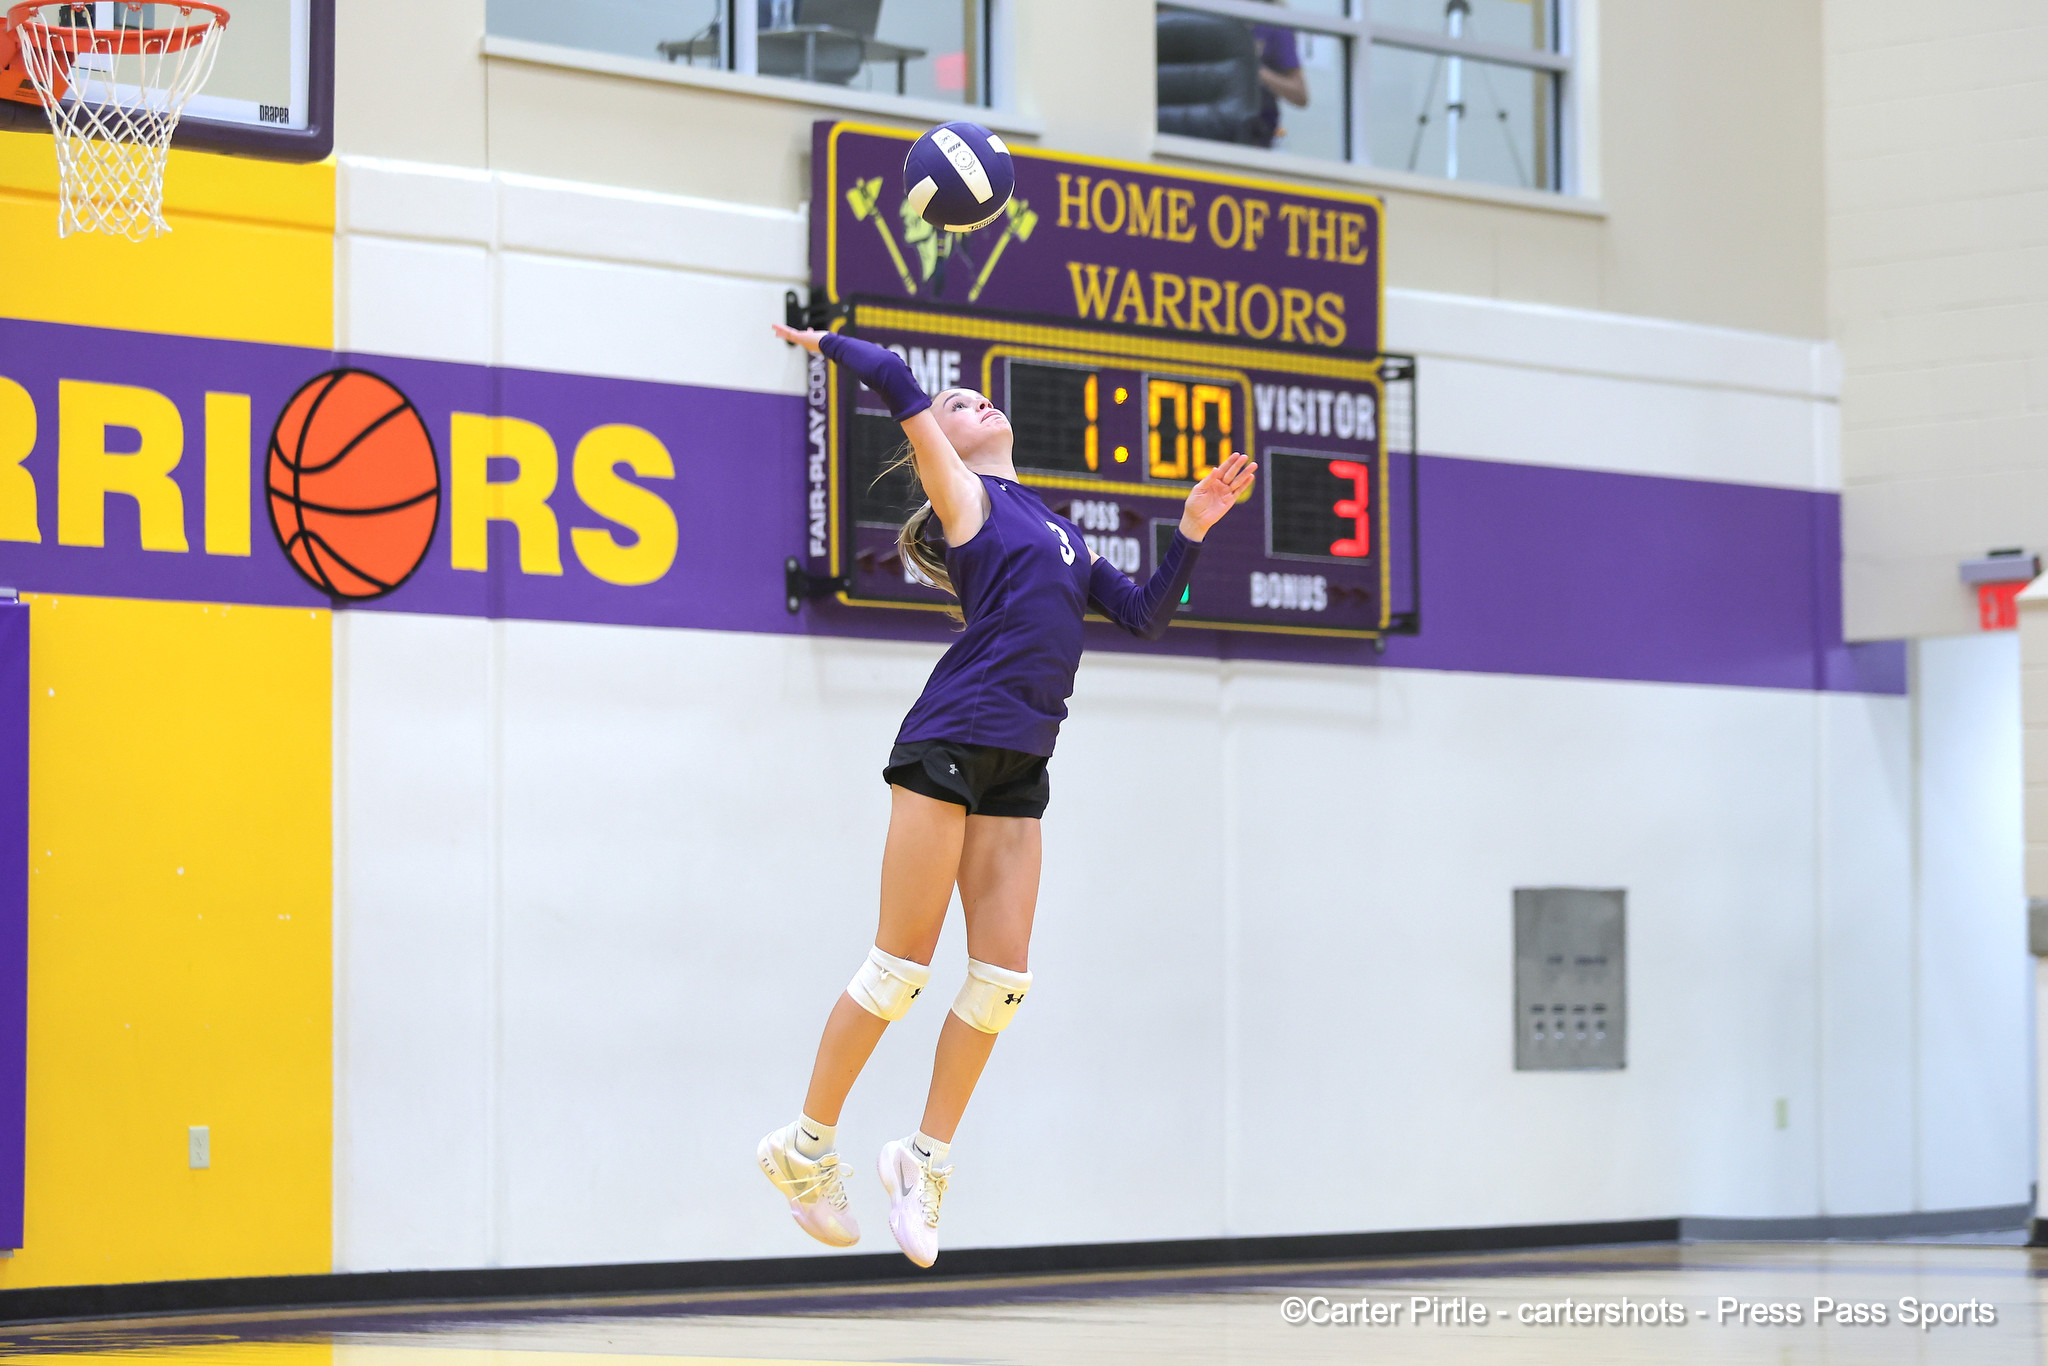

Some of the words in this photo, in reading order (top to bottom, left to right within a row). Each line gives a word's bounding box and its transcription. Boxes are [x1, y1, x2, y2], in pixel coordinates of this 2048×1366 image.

[1056, 173, 1197, 243] HOME
[1208, 194, 1270, 251] OF
[1279, 203, 1368, 265] THE
[1066, 261, 1347, 347] WARRIORS
[1253, 384, 1376, 441] VISITOR
[808, 351, 827, 557] FAIR-PLAY.COM
[1070, 499, 1120, 532] POSS
[1328, 459, 1370, 557] 3
[1045, 520, 1076, 566] 3
[1083, 533, 1140, 573] RIOD
[1250, 571, 1328, 611] BONUS
